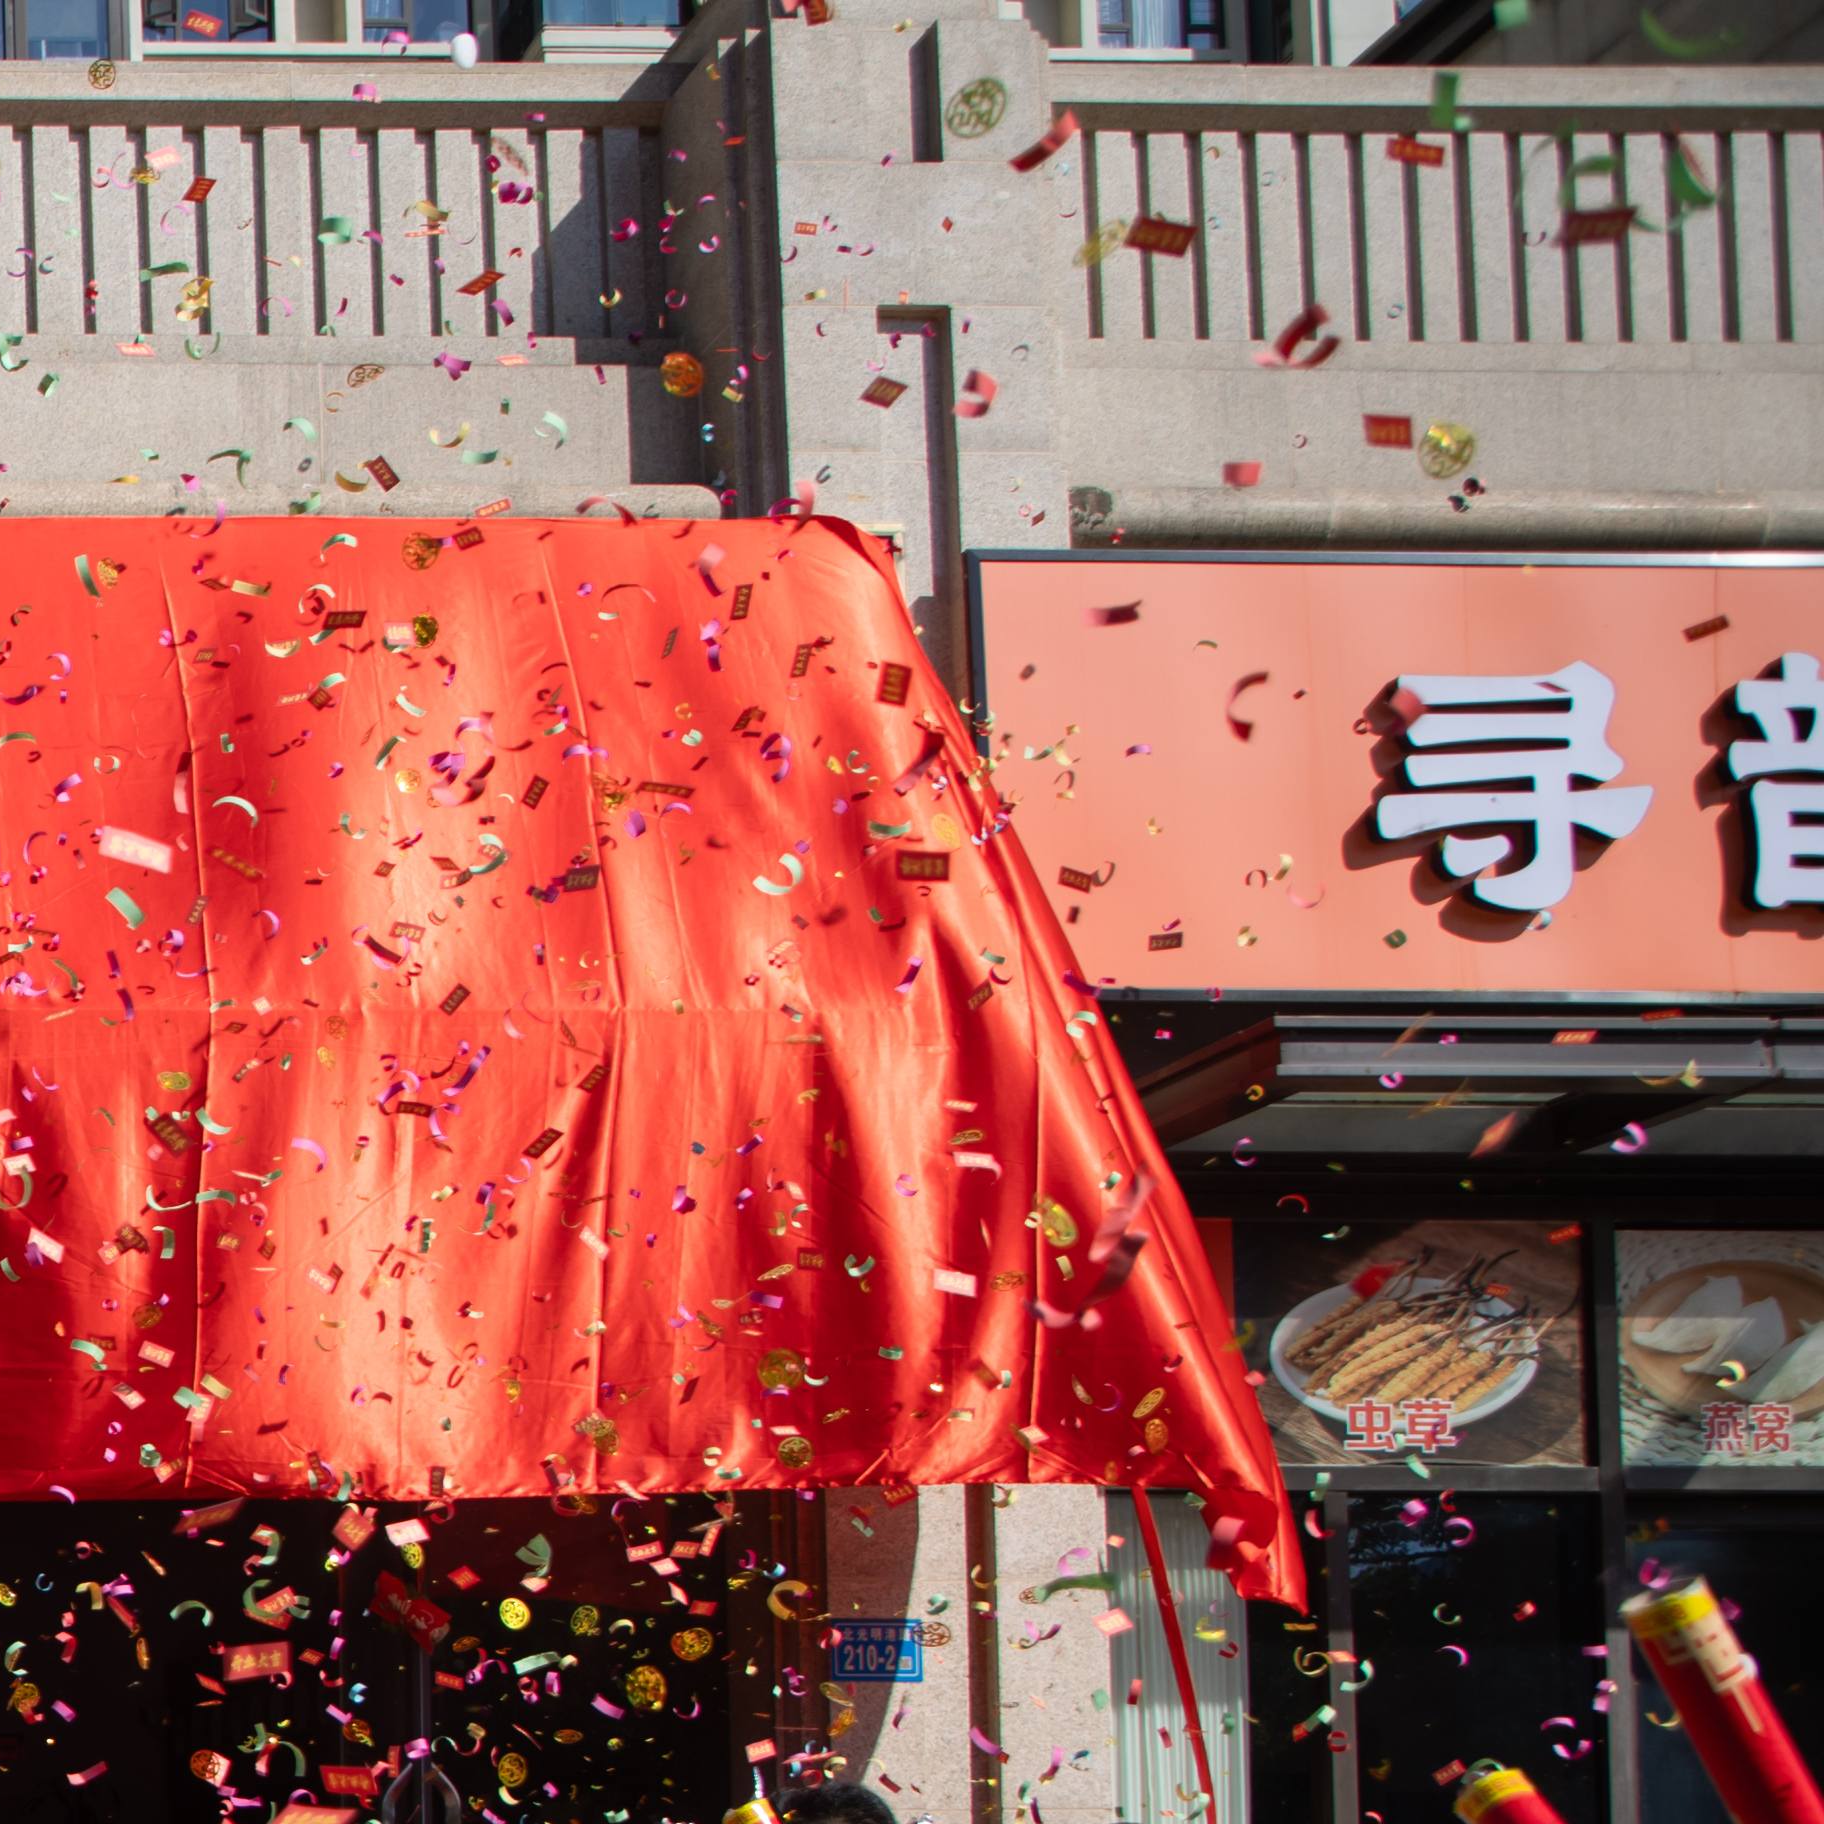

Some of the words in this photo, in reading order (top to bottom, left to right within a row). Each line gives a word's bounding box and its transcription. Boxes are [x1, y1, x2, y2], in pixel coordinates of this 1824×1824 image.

[1345, 1399, 1456, 1453] 虫草
[1703, 1402, 1794, 1454] 燕窝
[843, 1645, 897, 1671] 210-2
